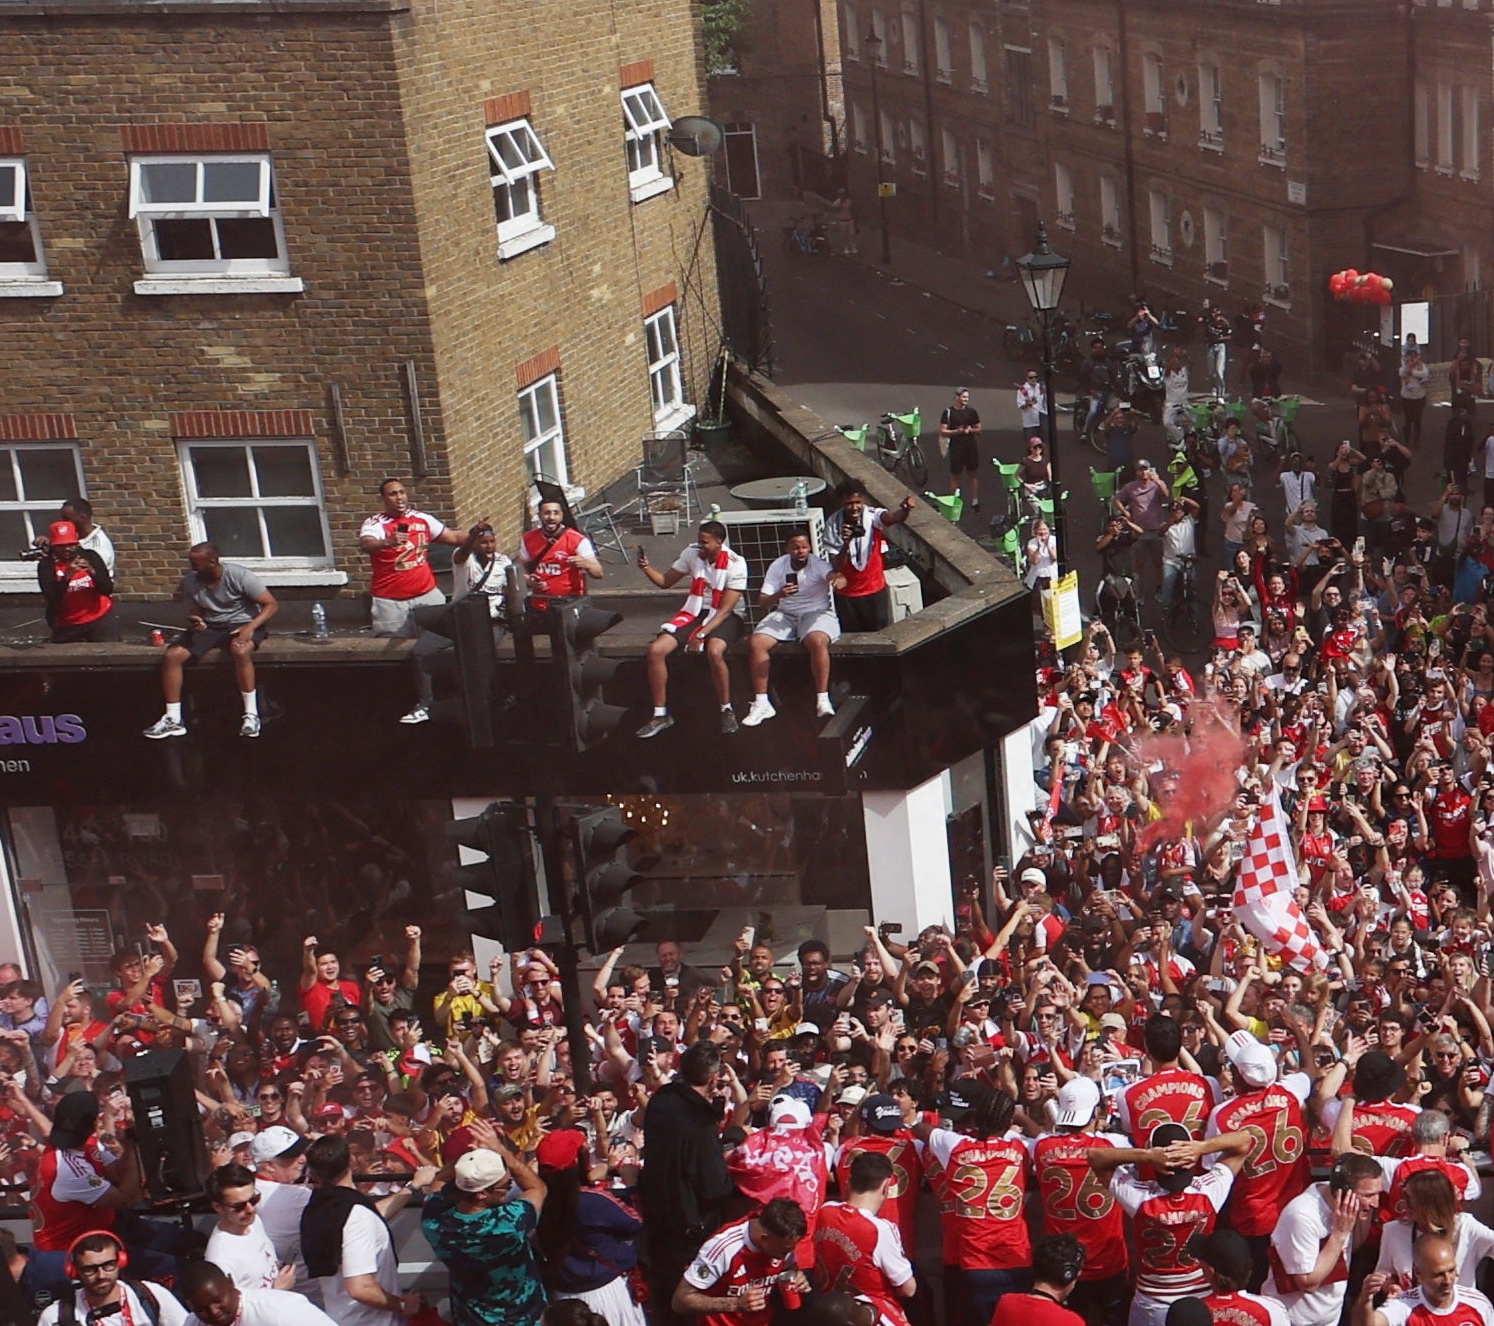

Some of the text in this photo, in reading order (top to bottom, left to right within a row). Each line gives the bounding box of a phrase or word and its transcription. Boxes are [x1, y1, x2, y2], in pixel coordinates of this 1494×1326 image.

[536, 562, 561, 575] JVC
[1134, 1082, 1206, 1111] CHAMPIONS
[1244, 1108, 1304, 1179] 26
[952, 1166, 1023, 1221] 26
[1041, 1165, 1115, 1220] 26
